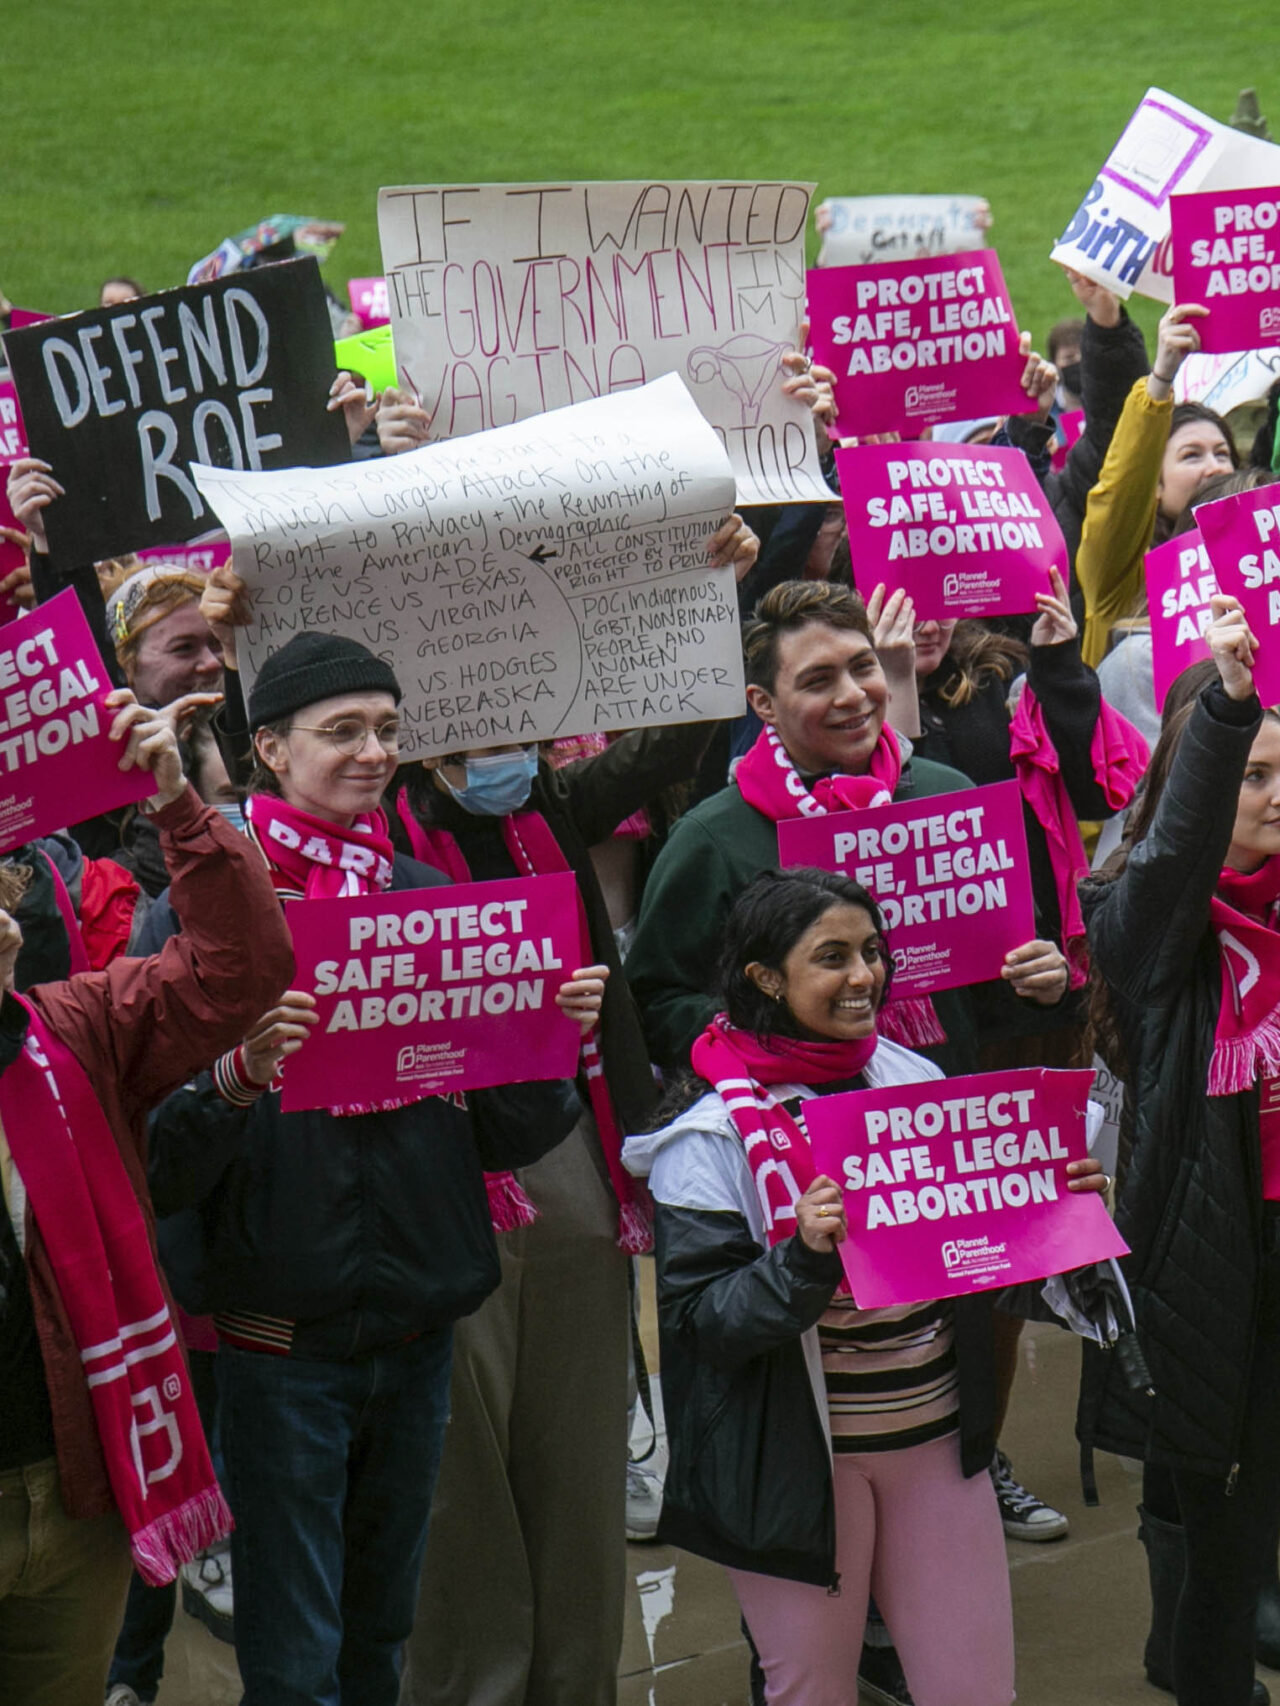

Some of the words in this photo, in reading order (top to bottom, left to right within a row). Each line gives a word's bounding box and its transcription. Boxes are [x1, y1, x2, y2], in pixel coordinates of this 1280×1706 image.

[387, 188, 481, 269] IF
[506, 188, 572, 264] I
[585, 184, 809, 252] WANTED
[1191, 236, 1275, 268] SAFE,
[387, 269, 442, 319] THE
[443, 242, 742, 359] GOVERNMENT
[736, 248, 804, 289] IN
[856, 267, 985, 309] PROTECT
[832, 310, 921, 345] SAFE,
[929, 296, 1010, 333] LEGAL
[42, 288, 270, 429] DEFEND
[847, 329, 1006, 376] ABORTION
[401, 344, 646, 435] VAGINA
[357, 475, 450, 519] Larger
[460, 463, 567, 499] Attack
[622, 450, 675, 479] the
[887, 458, 1006, 490] PROTECT
[253, 540, 338, 581] Right
[347, 529, 378, 549] to
[392, 507, 489, 552] Privacy
[502, 496, 550, 525] The
[561, 480, 668, 524] Rewriting
[670, 471, 694, 497] of
[866, 492, 957, 527] SAFE,
[961, 491, 1041, 519] LEGAL
[300, 564, 344, 584] the
[361, 536, 473, 576] American
[498, 513, 634, 557] Demographic
[554, 552, 639, 580] PROTECTED
[644, 546, 664, 562] BY
[668, 538, 705, 554] THE
[569, 540, 608, 562] ALL
[888, 522, 1043, 560] ABORTION
[400, 552, 498, 586] WADE
[569, 566, 631, 590] RIGHT
[643, 558, 664, 575] TO
[245, 599, 382, 646] LAWRENCE
[440, 567, 527, 600] TEXAS,
[418, 588, 536, 632] VIRGINIA
[416, 621, 540, 658] GEORGIA
[584, 634, 652, 661] PEOPLE
[665, 627, 706, 649] AND
[591, 644, 678, 677] WOMEN
[460, 650, 558, 689] HODGES
[585, 675, 637, 700] ARE
[643, 667, 736, 692] UNDER
[403, 679, 556, 723] NEBRASKA
[594, 691, 703, 725] ATTACK
[834, 807, 984, 863] PROTECT
[915, 840, 1014, 887] LEGAL
[349, 900, 527, 950] PROTECT
[878, 877, 1008, 931] ORTION
[314, 953, 429, 996] SAFE,
[441, 937, 562, 981] LEGAL
[325, 979, 544, 1033] ABORTION
[864, 1089, 1036, 1145] PROTECT
[842, 1144, 946, 1190] SAFE,
[952, 1126, 1069, 1175] LEGAL
[866, 1168, 1058, 1230] ABORTION
[956, 1235, 988, 1249] Planned
[959, 1242, 1006, 1258] Parenthood
